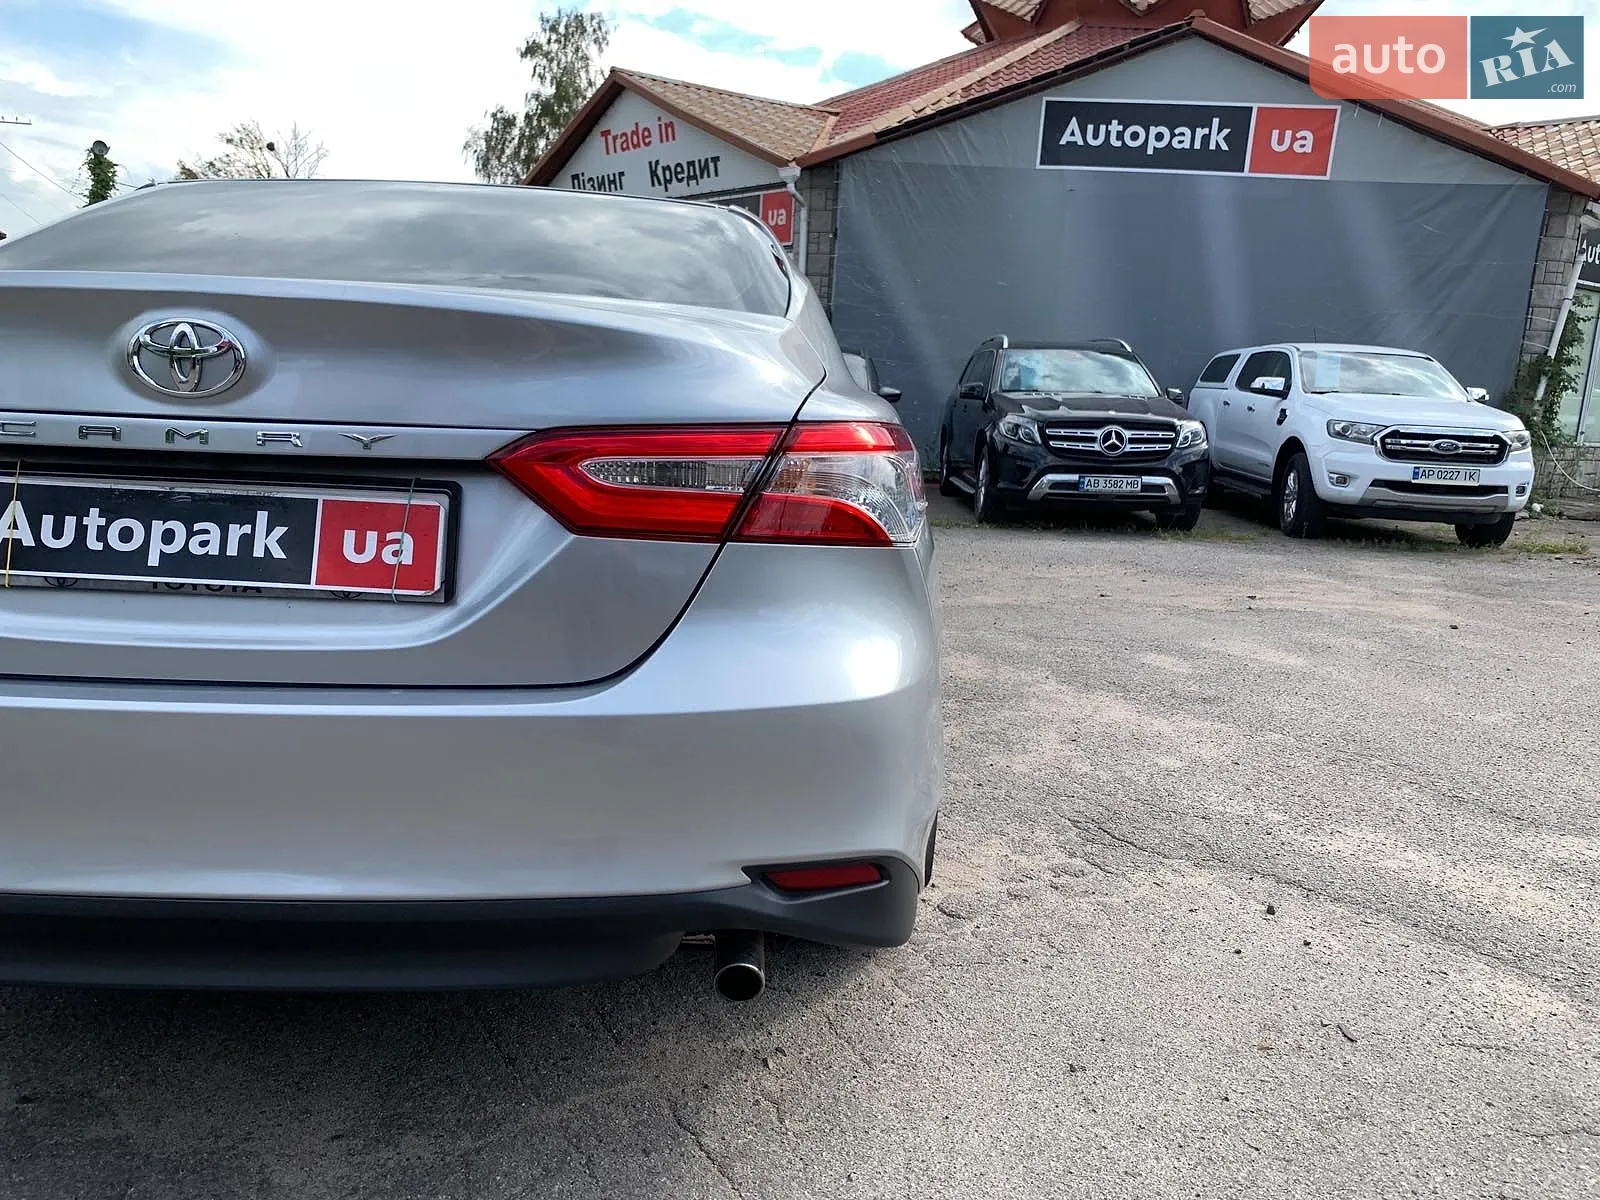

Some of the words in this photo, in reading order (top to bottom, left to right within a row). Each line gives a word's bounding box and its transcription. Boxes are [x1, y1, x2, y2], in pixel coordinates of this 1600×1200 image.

[600, 122, 652, 155] Trade
[657, 116, 676, 143] in
[1059, 116, 1231, 155] Autopark
[1270, 129, 1313, 153] ua
[648, 156, 721, 192] Кредит
[767, 208, 787, 226] ua
[0, 420, 398, 449] CAMRY
[1086, 479, 1100, 489] AB
[1102, 479, 1124, 489] 3582
[1420, 469, 1435, 480] AP
[1436, 470, 1461, 481] 0227
[0, 500, 289, 567] Autopark
[343, 528, 414, 566] ua
